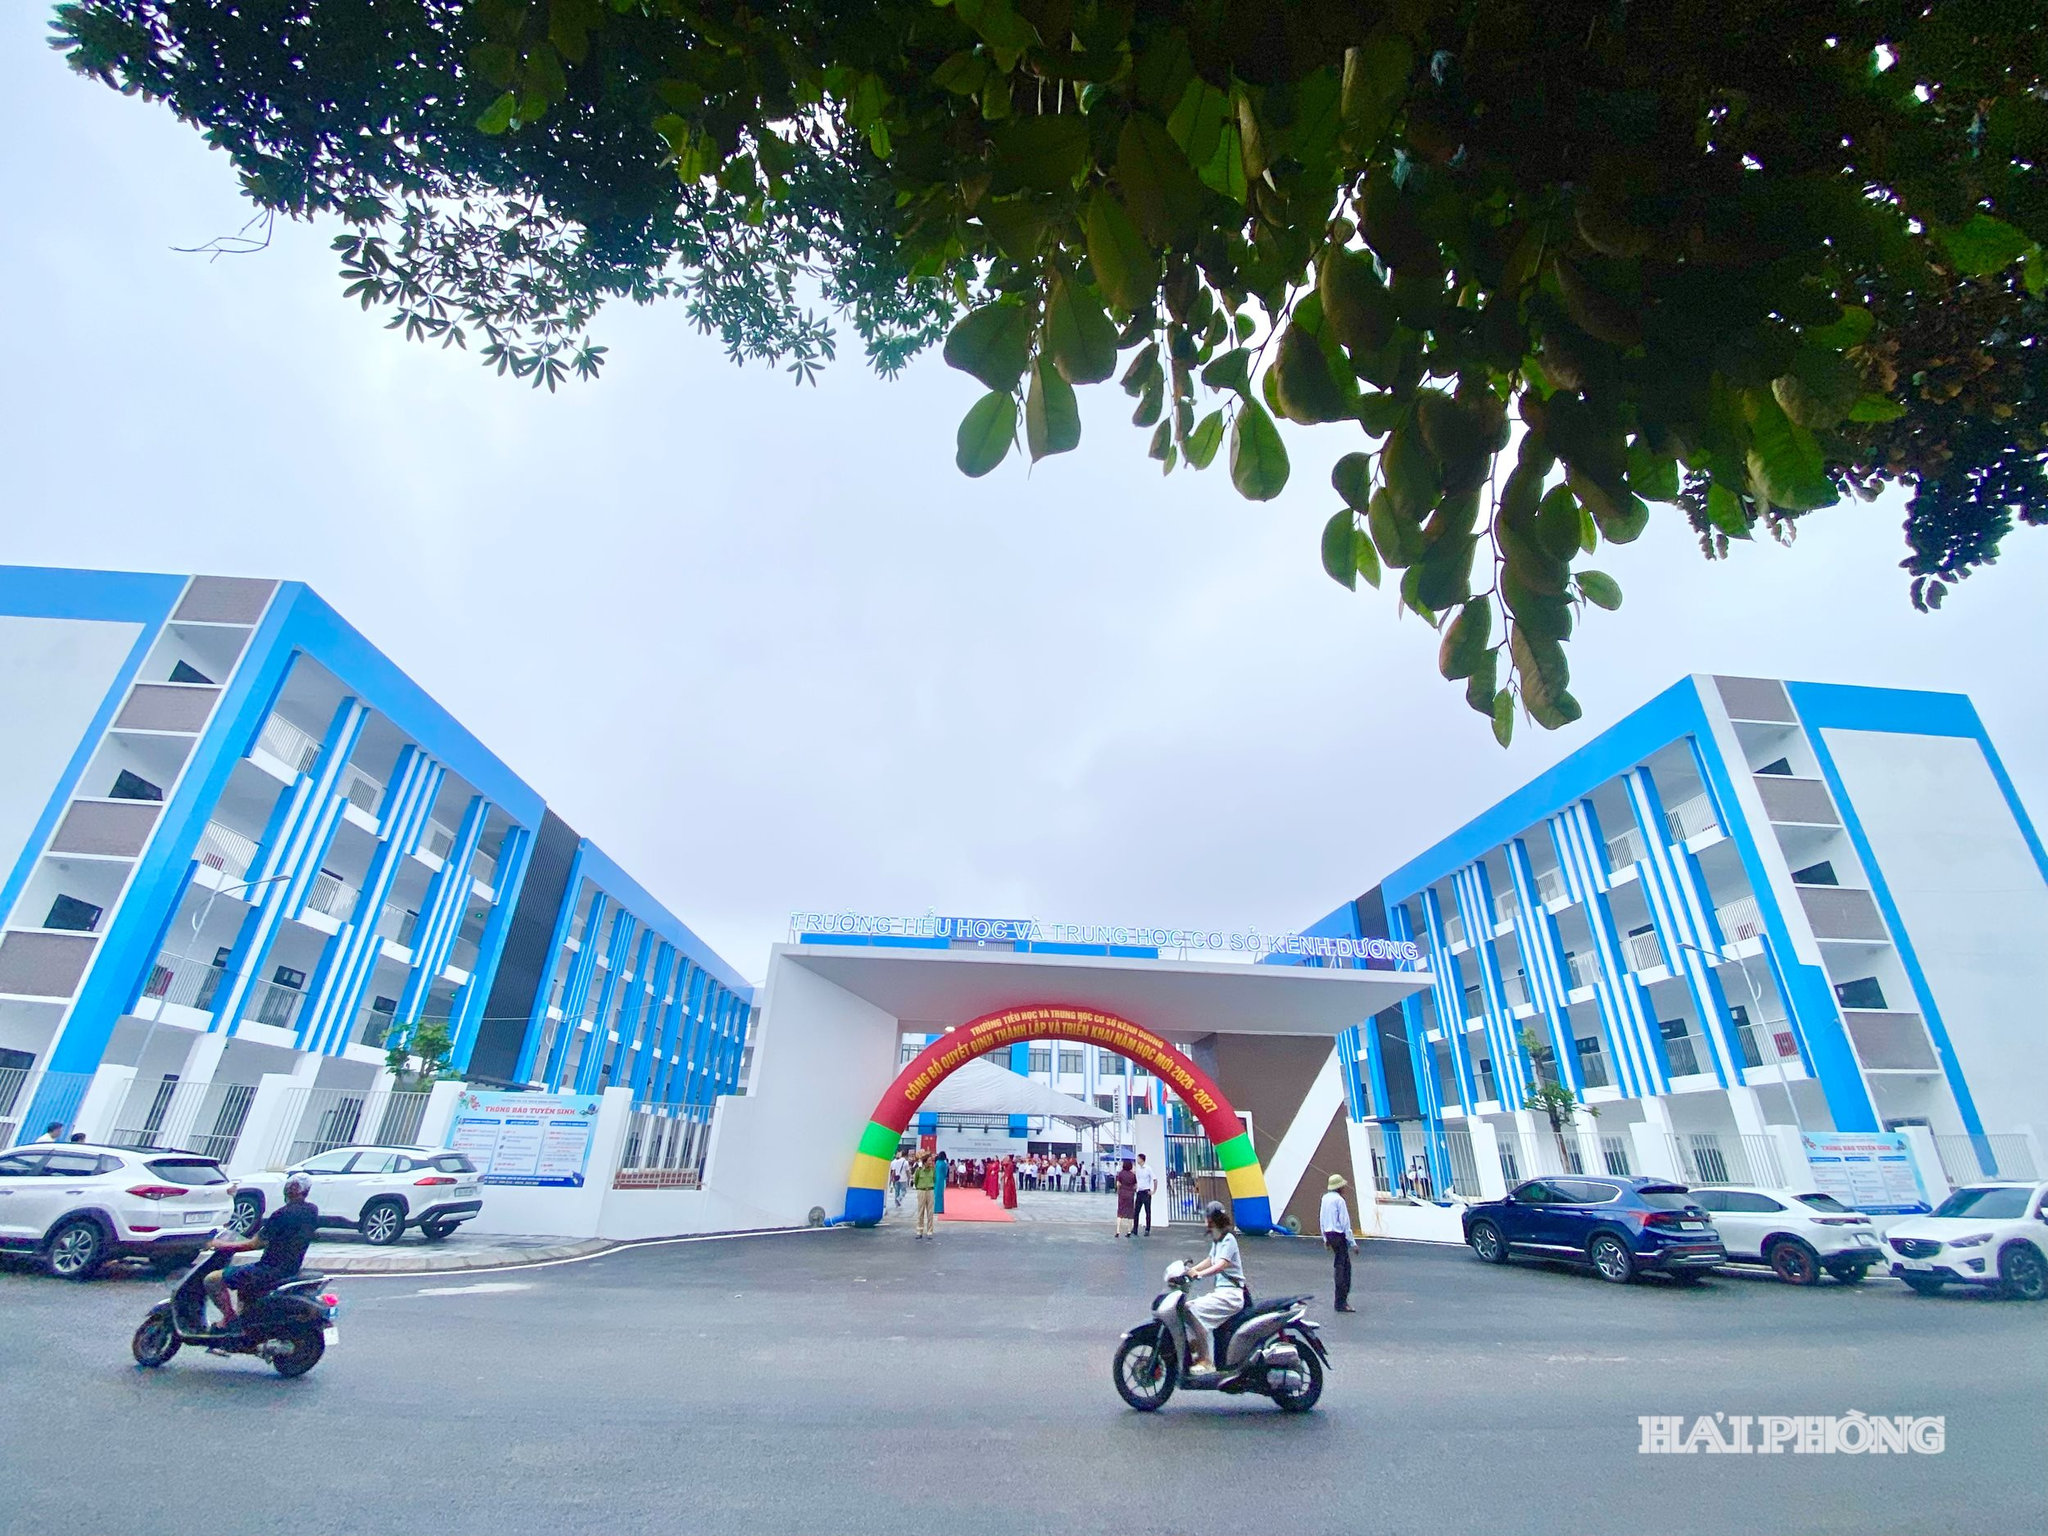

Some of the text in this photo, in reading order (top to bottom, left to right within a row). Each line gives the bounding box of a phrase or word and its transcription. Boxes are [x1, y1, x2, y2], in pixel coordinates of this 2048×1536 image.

[791, 905, 1419, 960] TRƯỜNG TIỂU HỌC VÀ TRUNG HỌC CƠ SỞ KÊNH DƯƠNG
[970, 1018, 1002, 1036] TRƯỜNG
[1002, 1011, 1021, 1025] TIỂU
[1021, 1010, 1038, 1021] HỌC
[1038, 1008, 1050, 1019] VÀ
[1050, 1010, 1076, 1020] TRUNG
[1077, 1011, 1093, 1022] HỌC
[1094, 1014, 1105, 1023] CƠ
[1106, 1017, 1117, 1027] SỞ
[904, 1072, 931, 1100] CÔNG
[927, 1057, 943, 1079] BỐ
[941, 1041, 970, 1069] QUYẾT
[970, 1033, 995, 1053] ĐỊNH
[995, 1024, 1027, 1041] THÀNH
[1028, 1020, 1047, 1035] LẬP
[1047, 1019, 1060, 1034] VÀ
[1062, 1020, 1089, 1036] TRIỂN
[1090, 1025, 1114, 1042] KHAI
[1113, 1031, 1137, 1051] NĂM
[1136, 1041, 1157, 1060] HỌC
[1153, 1052, 1174, 1072] MỚI
[1170, 1065, 1195, 1090] 2026
[1193, 1089, 1218, 1114] 2027
[485, 1105, 510, 1113] THÔNG
